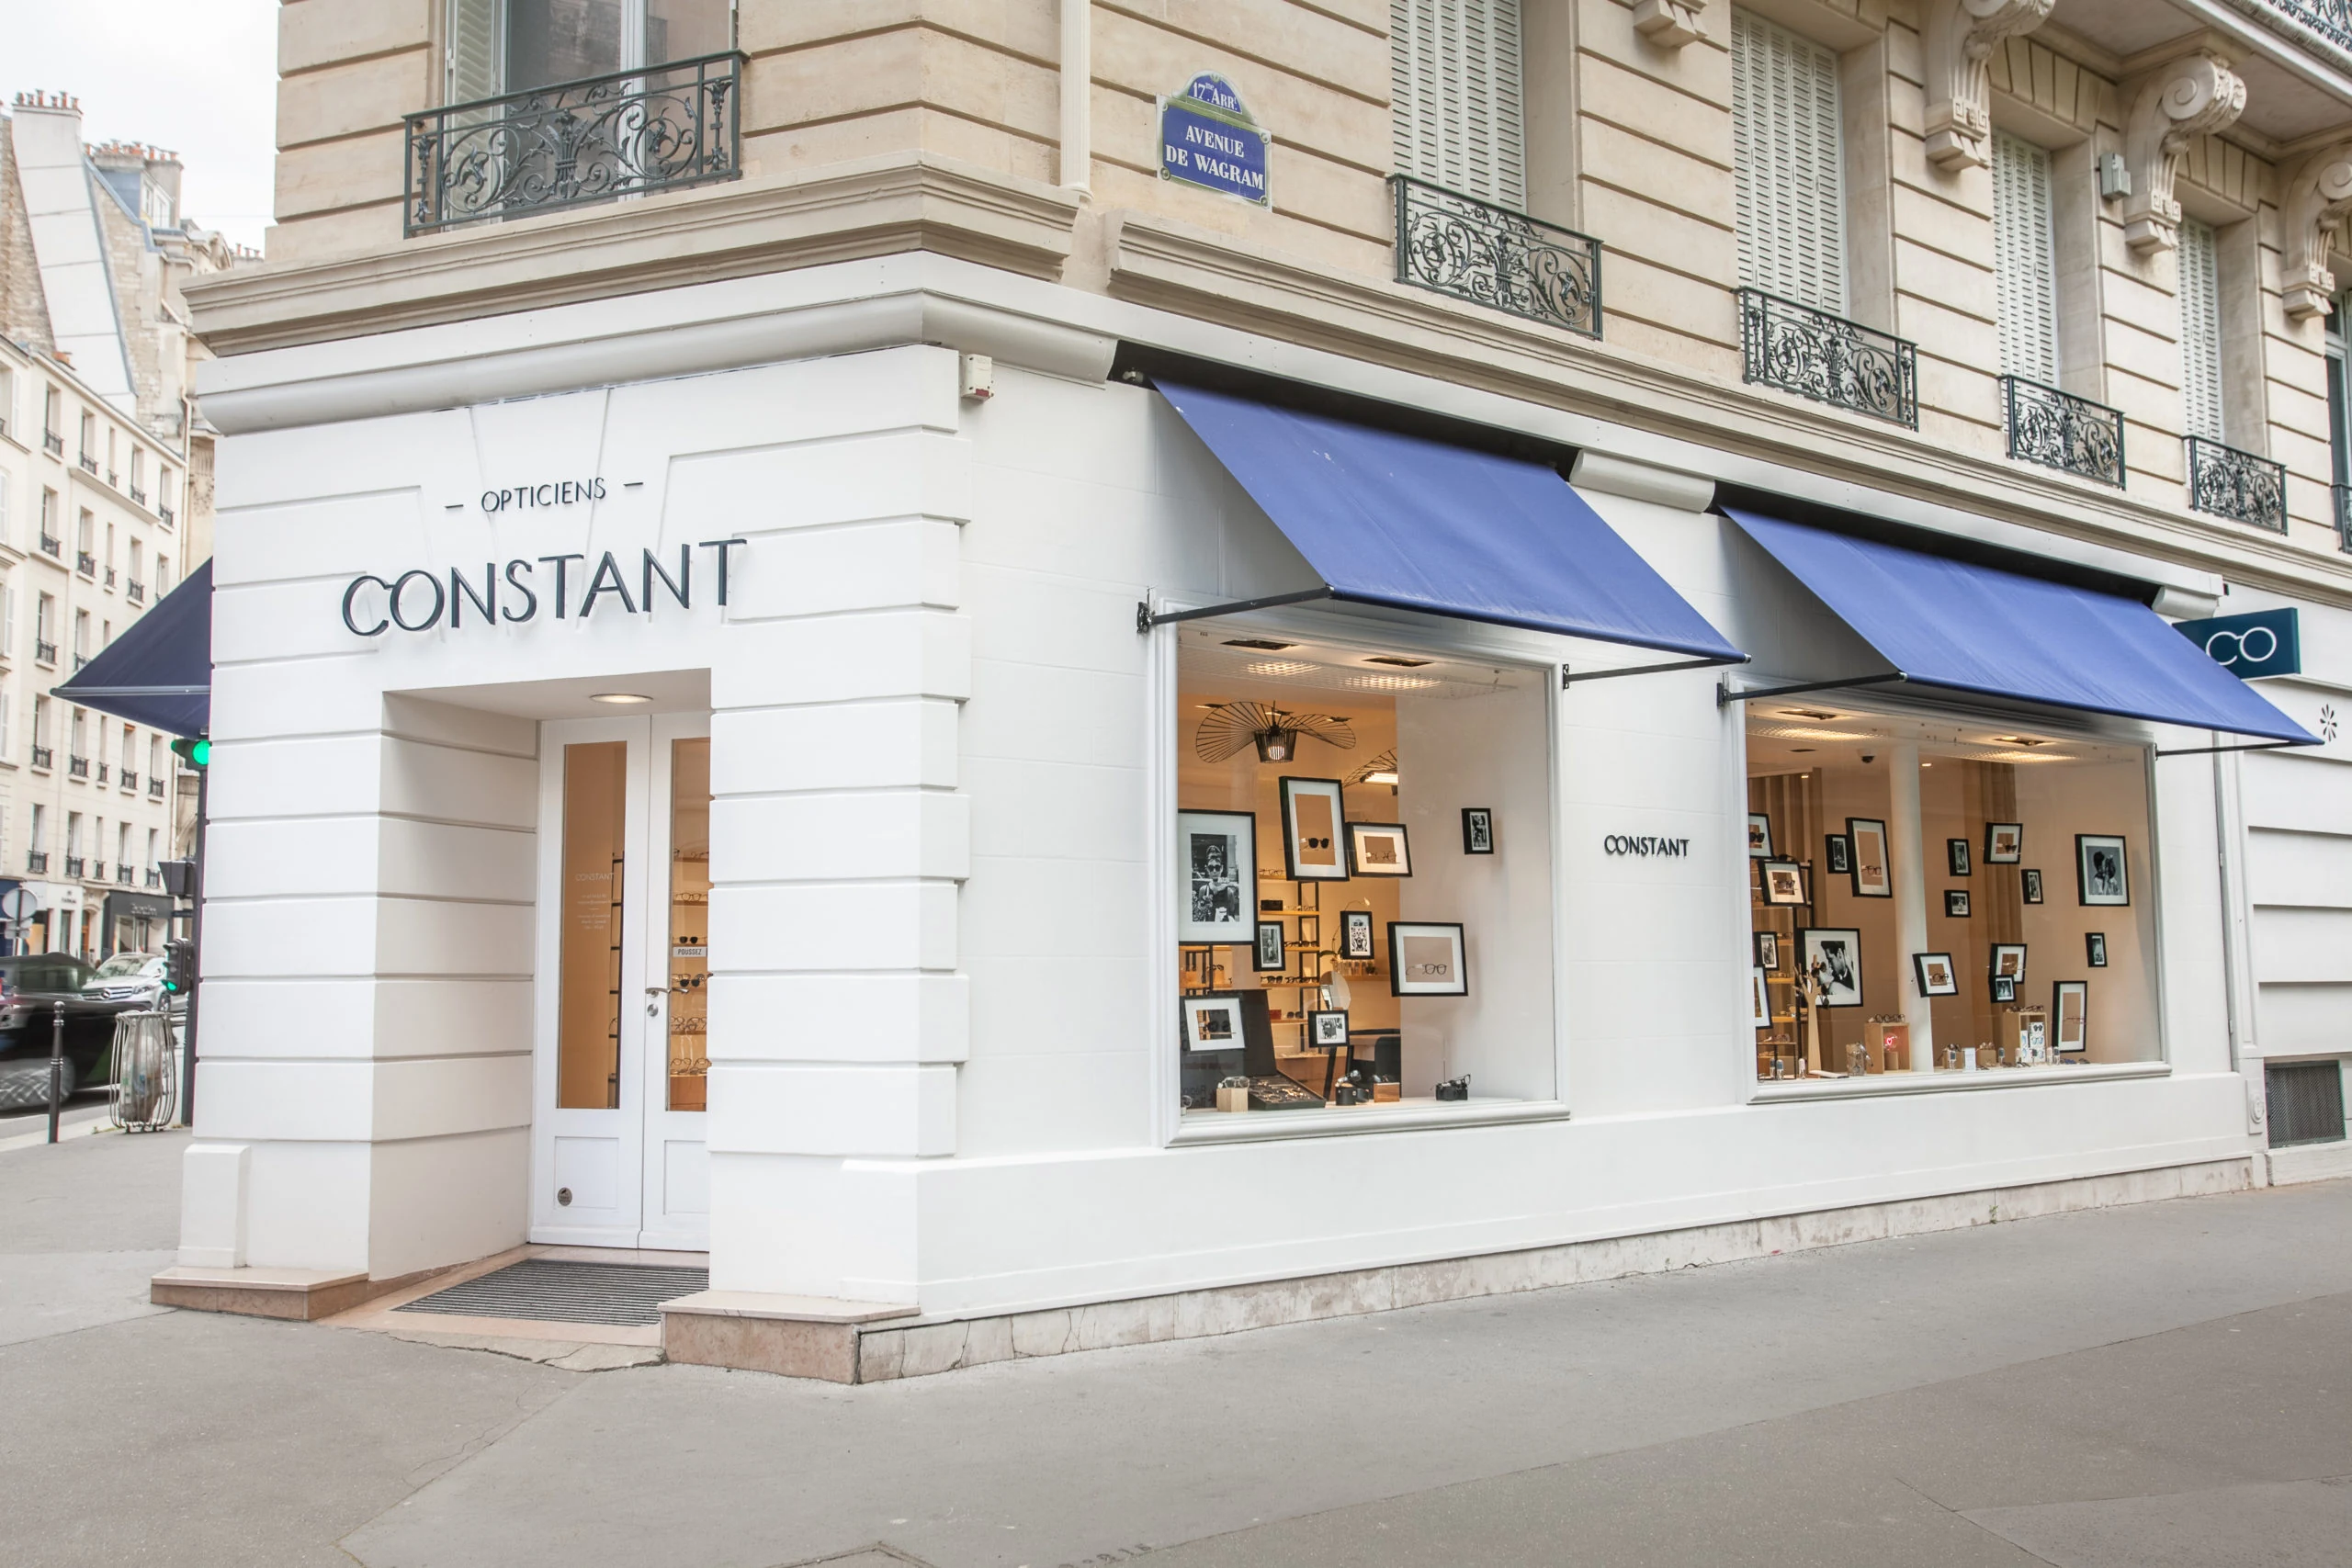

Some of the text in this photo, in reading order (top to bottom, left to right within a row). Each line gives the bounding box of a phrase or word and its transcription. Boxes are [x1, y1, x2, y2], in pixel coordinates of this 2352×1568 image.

[1185, 125, 1245, 158] AVENUE
[1165, 144, 1264, 190] DE WAGRAM
[481, 477, 606, 513] OPTICIENS
[342, 538, 747, 637] CONSTANT
[1603, 834, 1690, 857] CONSTANT
